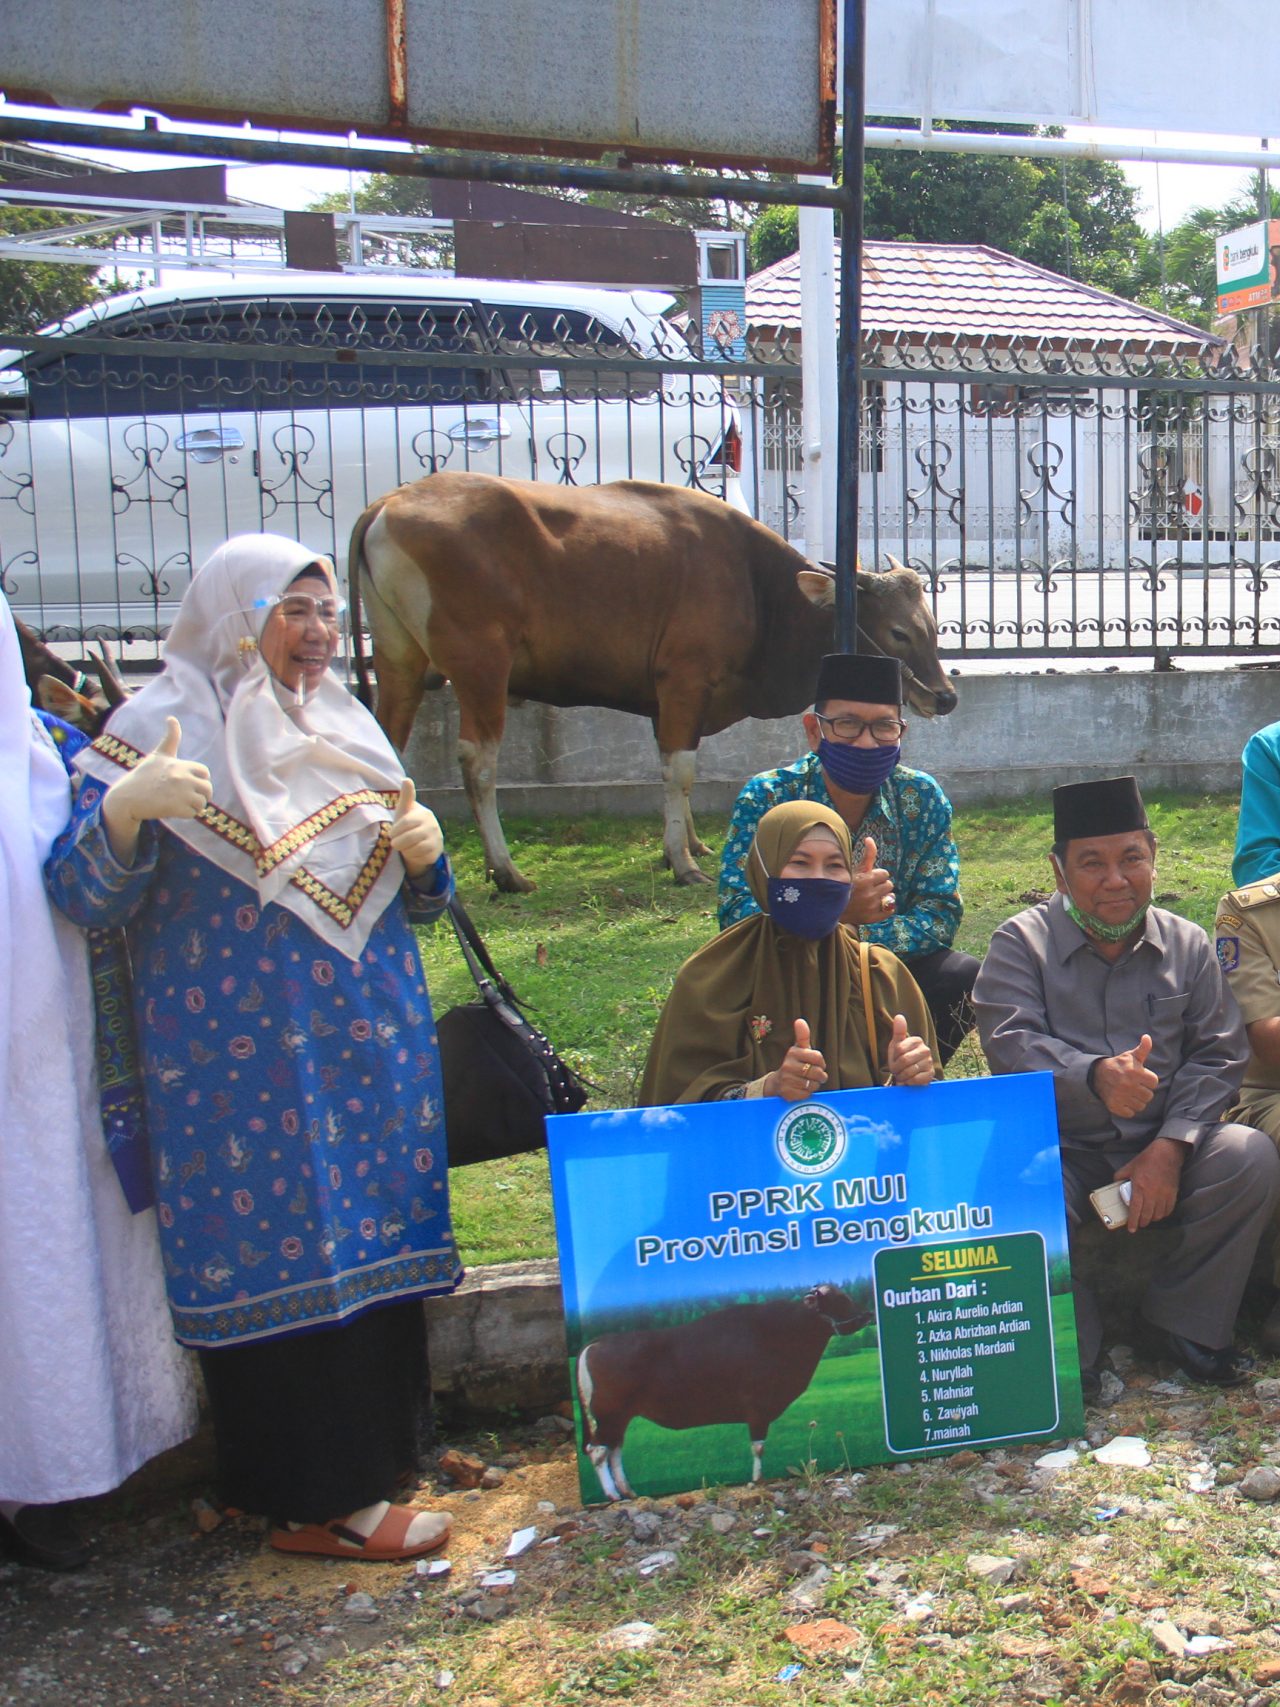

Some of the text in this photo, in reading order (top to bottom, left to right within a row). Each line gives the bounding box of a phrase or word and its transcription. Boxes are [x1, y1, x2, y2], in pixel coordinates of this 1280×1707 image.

[711, 1174, 906, 1220] PPRK MUI
[637, 1204, 992, 1266] Provinsi Bengkulu
[922, 1245, 998, 1272] SELUMA
[884, 1287, 940, 1307] Qurban
[946, 1280, 977, 1299] Dari
[915, 1301, 1023, 1325] 1. Akira Aurelio Ardian
[917, 1319, 1030, 1344] 2. Azka Abrizhan Ardian
[918, 1339, 1015, 1363] 3. Nikholas Mardani
[920, 1365, 973, 1383] 4. Nuryllah
[921, 1385, 974, 1402] 5. Mahniar
[923, 1409, 932, 1422] 6.
